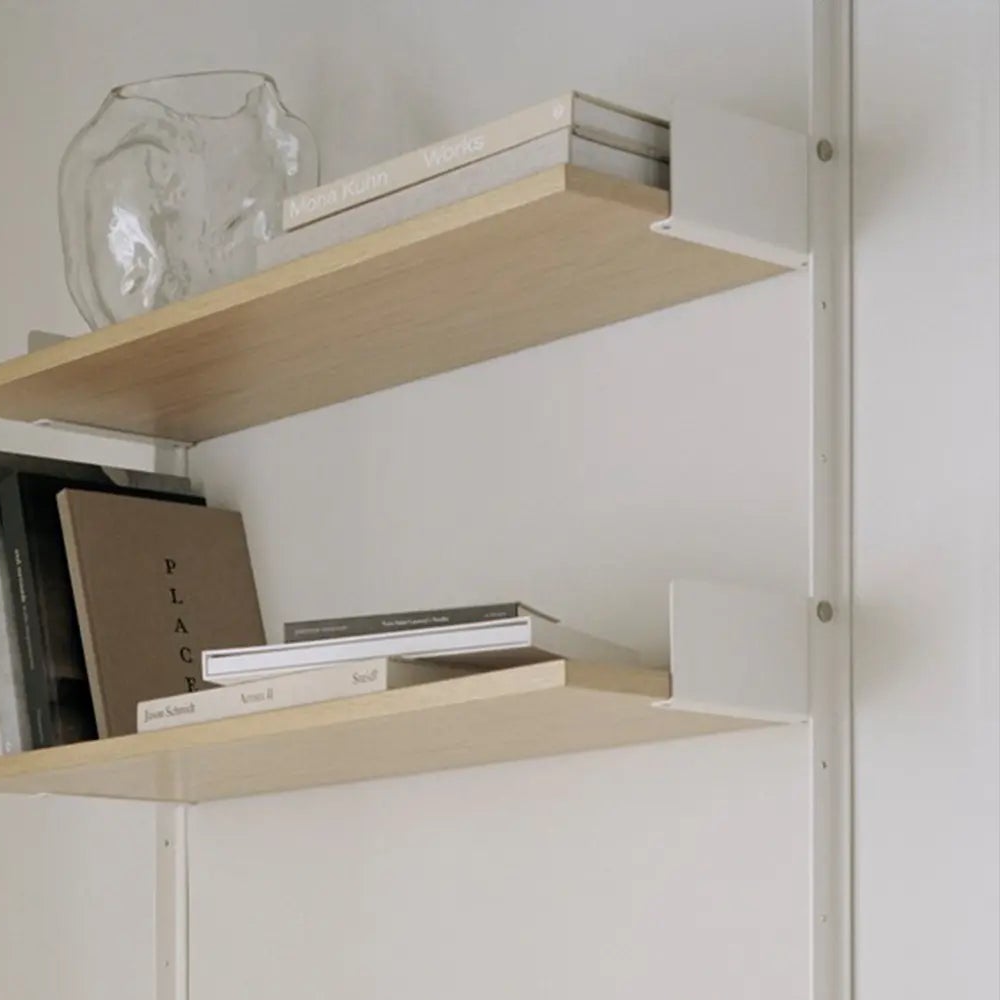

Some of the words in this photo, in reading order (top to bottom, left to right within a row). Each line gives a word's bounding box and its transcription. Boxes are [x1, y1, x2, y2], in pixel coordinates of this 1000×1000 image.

[423, 134, 485, 168] Works
[289, 188, 336, 218] Mona
[341, 171, 390, 199] Kuhn
